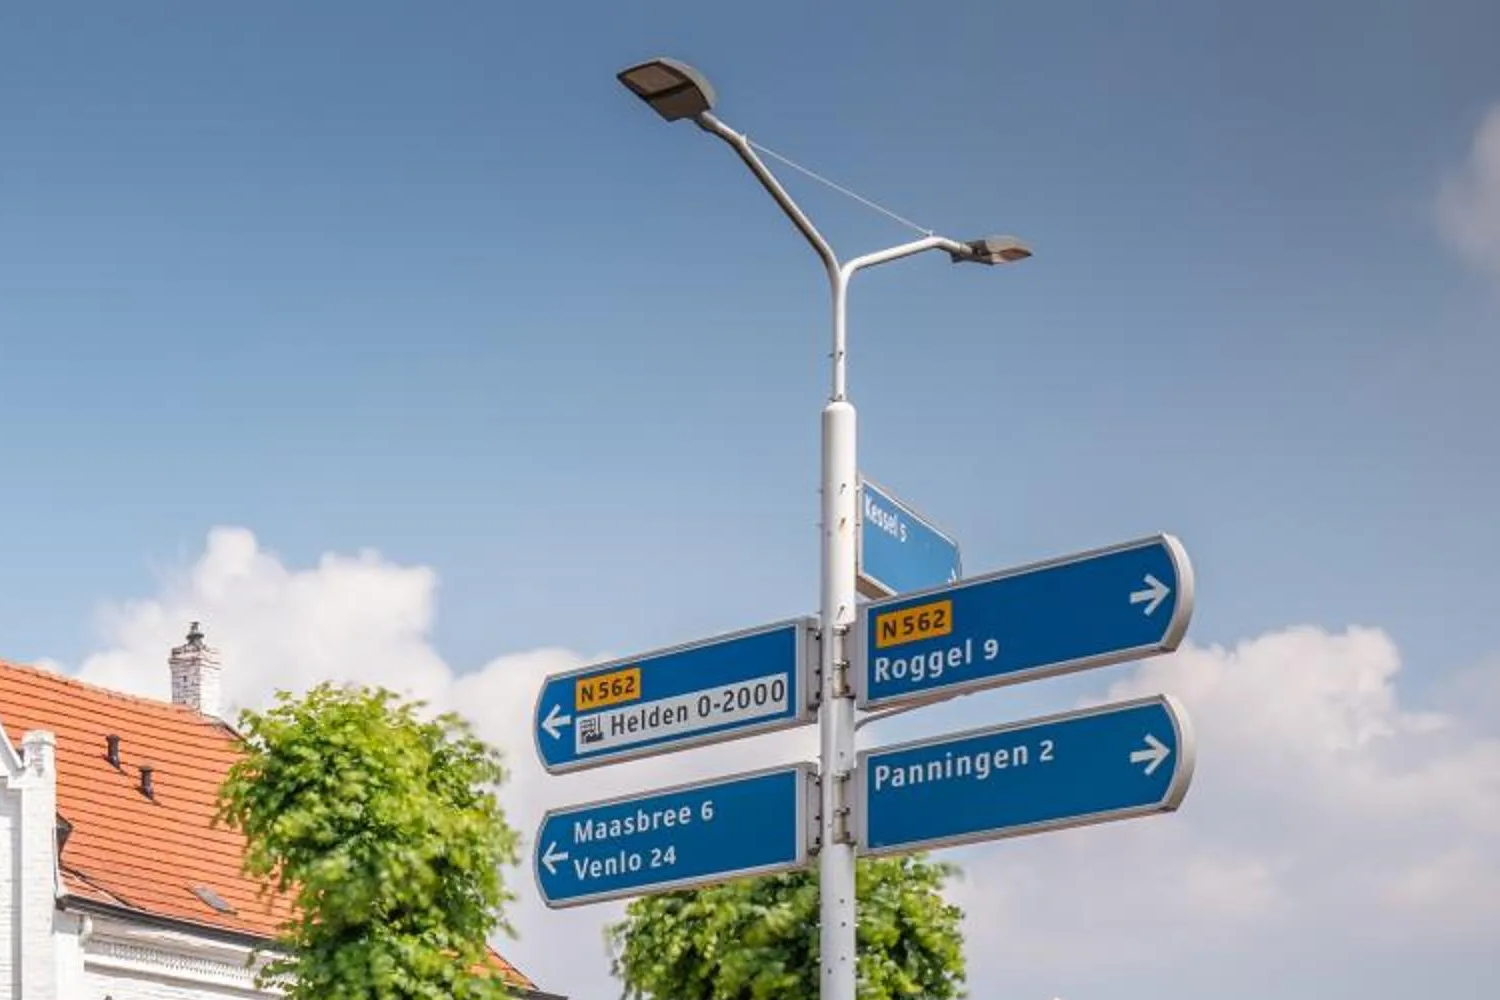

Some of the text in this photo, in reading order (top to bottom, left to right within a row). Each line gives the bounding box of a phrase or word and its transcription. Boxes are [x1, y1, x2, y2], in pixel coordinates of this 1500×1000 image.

[865, 494, 898, 538] Kessel
[875, 638, 999, 684] Roggel 9
[611, 678, 785, 737] Helden 0-2000
[875, 739, 1054, 791] Panningen 2
[573, 801, 714, 844] Maasbree 6
[573, 845, 677, 881] Venlo 24
